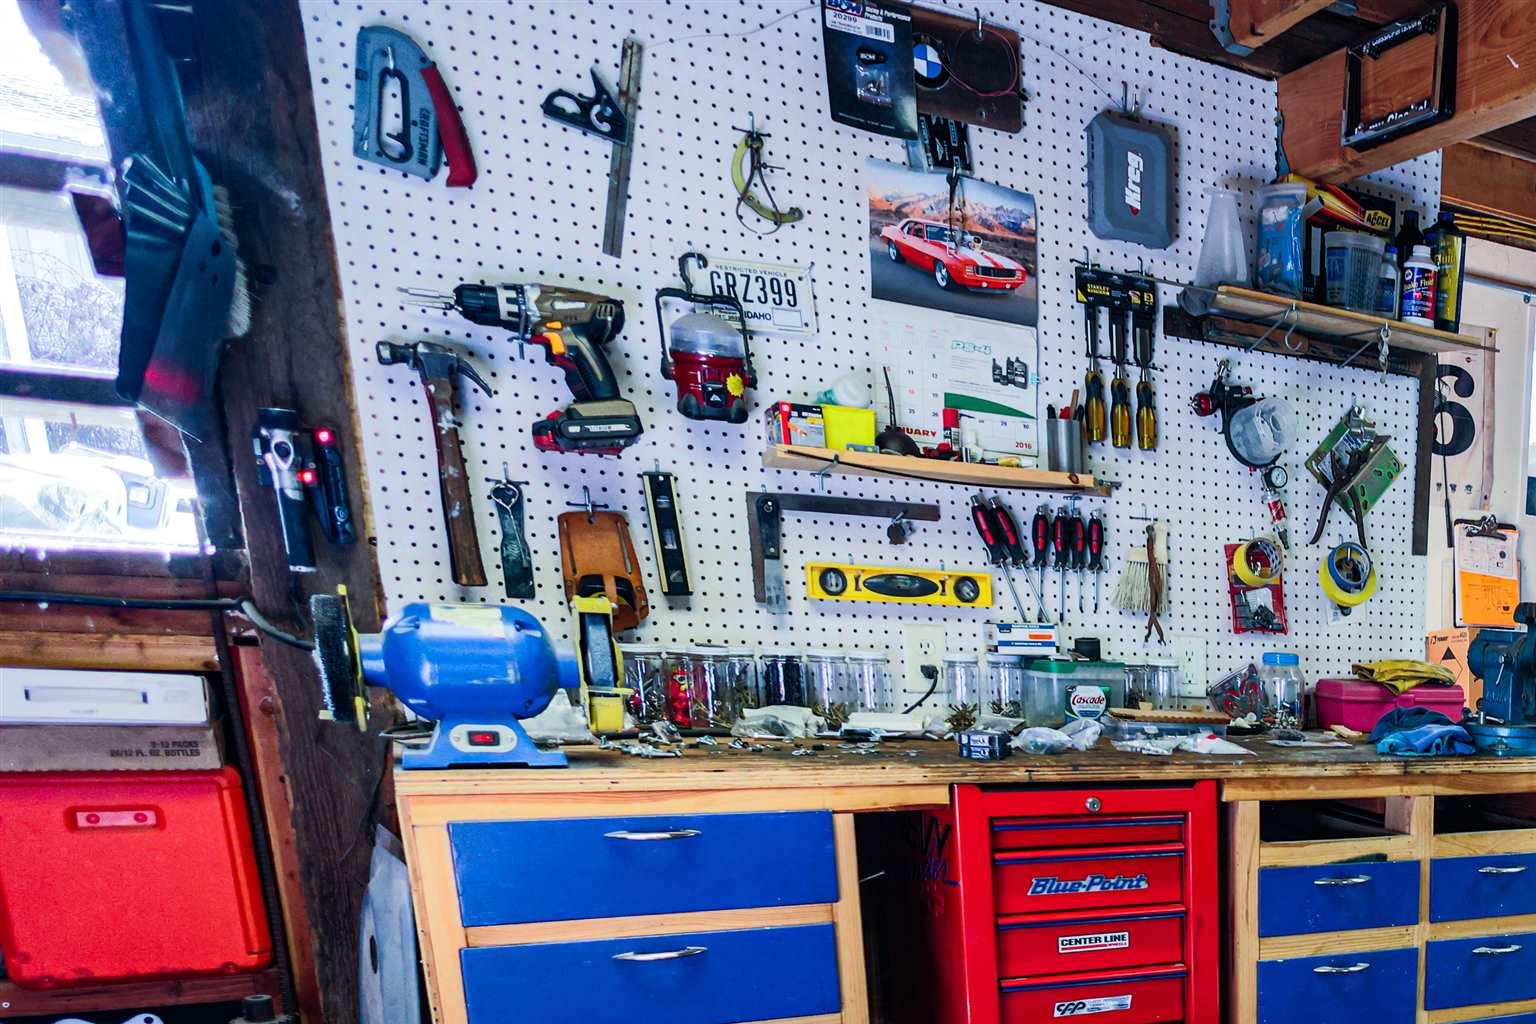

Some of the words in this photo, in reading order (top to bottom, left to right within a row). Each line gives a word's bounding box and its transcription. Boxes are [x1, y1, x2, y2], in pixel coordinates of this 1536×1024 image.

[1366, 213, 1391, 228] ACCEL
[759, 270, 787, 278] VEHICLE
[709, 271, 798, 308] GRZ399
[744, 310, 772, 321] IDAHO
[1072, 694, 1106, 706] Cascade
[172, 740, 199, 749] PACKS
[165, 749, 200, 757] BOTTLES
[1029, 874, 1148, 895] Blue-Point
[1060, 936, 1103, 947] CENTER
[1104, 933, 1127, 942] LINE
